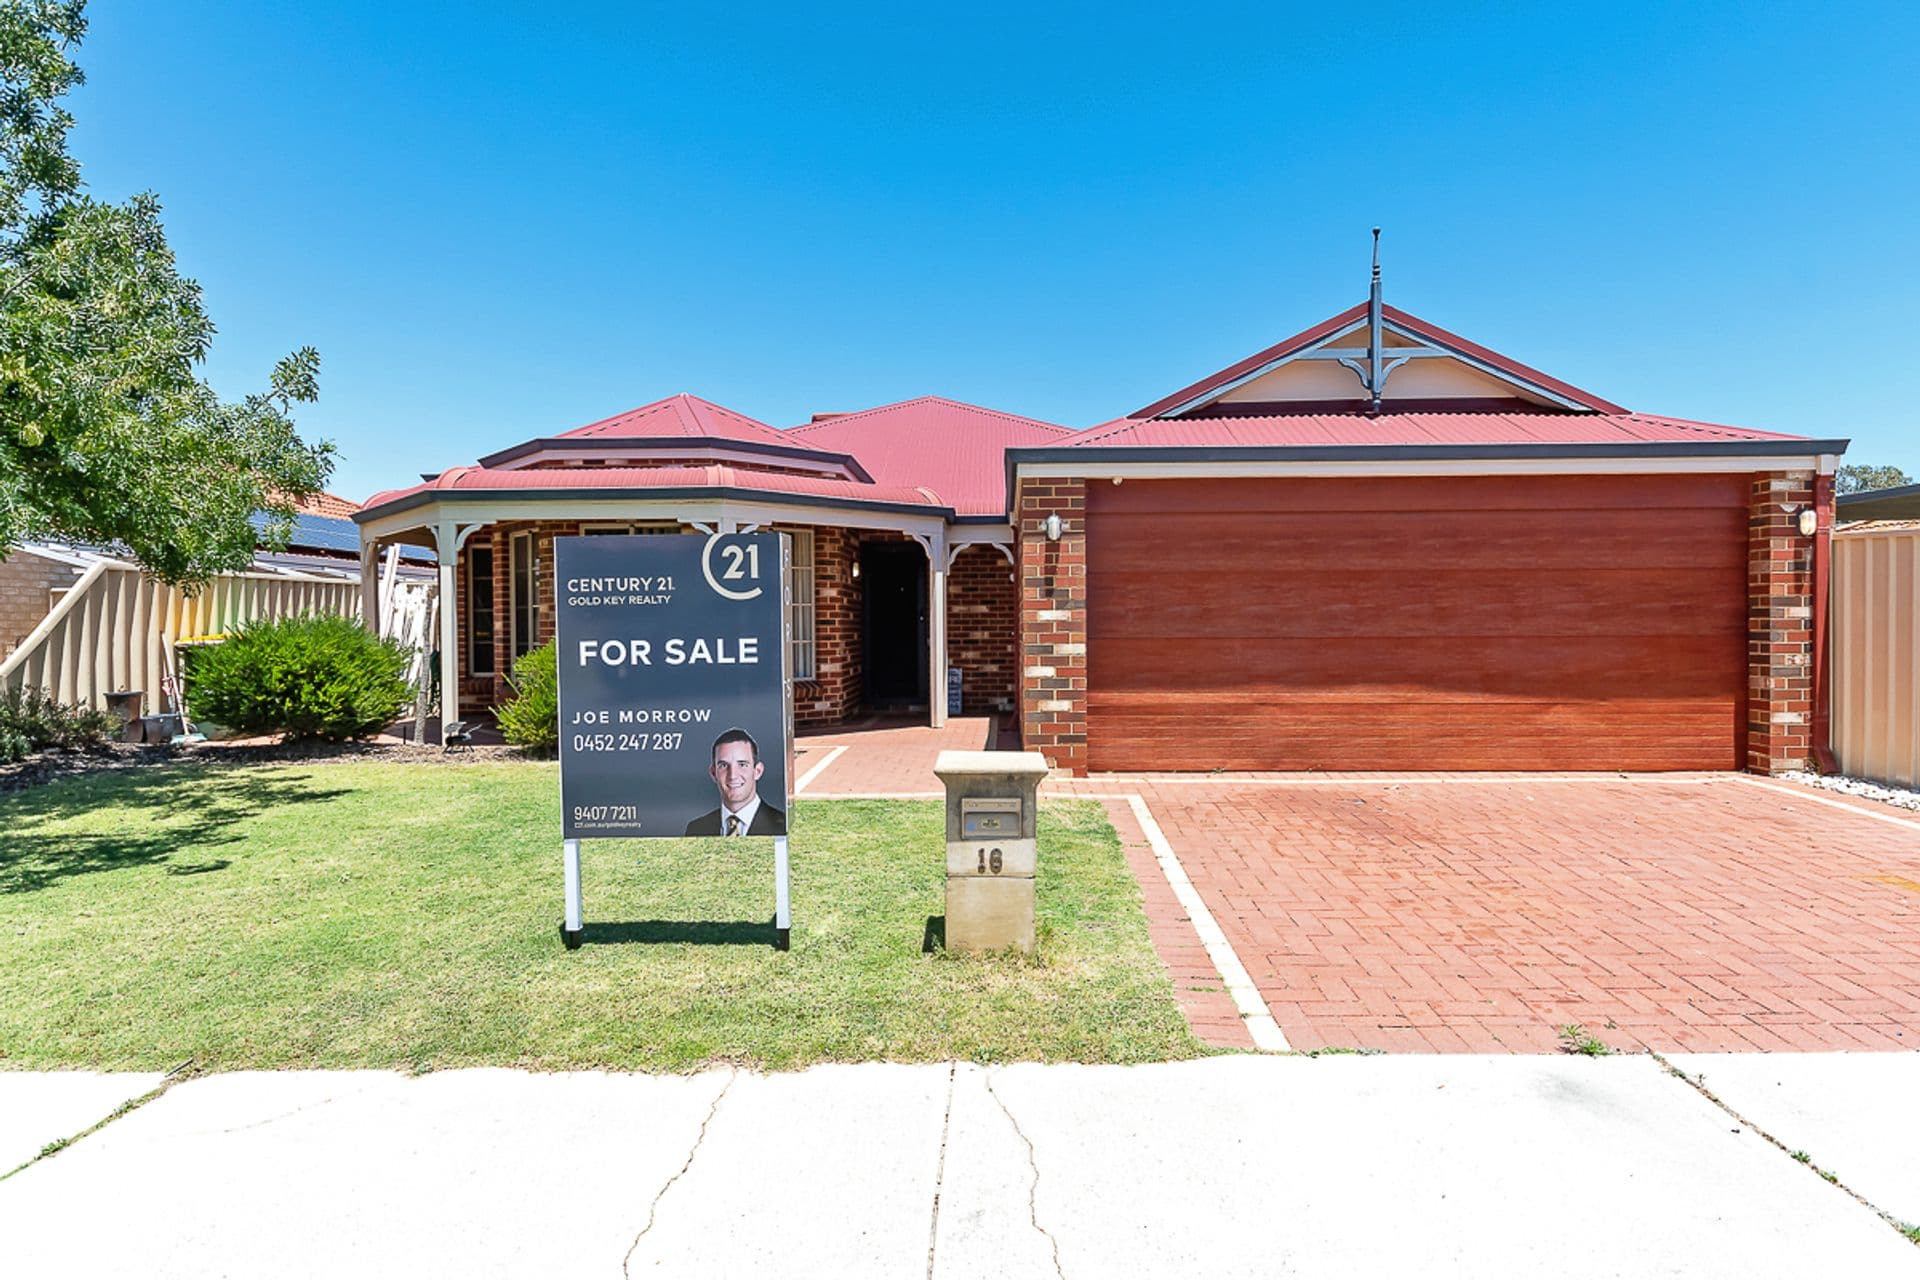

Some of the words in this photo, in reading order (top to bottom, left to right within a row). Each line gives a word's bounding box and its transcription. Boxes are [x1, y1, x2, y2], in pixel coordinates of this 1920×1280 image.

[567, 577, 652, 592] CENTURY
[567, 596, 601, 606] GOLD
[603, 595, 626, 605] KEY
[628, 595, 671, 605] REALTY
[578, 639, 652, 667] FOR
[664, 637, 759, 665] SALE
[572, 711, 609, 724] JOE
[619, 709, 711, 723] MORROW
[574, 735, 614, 751] 0452
[618, 734, 648, 751] 247
[652, 733, 682, 750] 287
[574, 806, 607, 821] 9407
[611, 805, 637, 820] 7211
